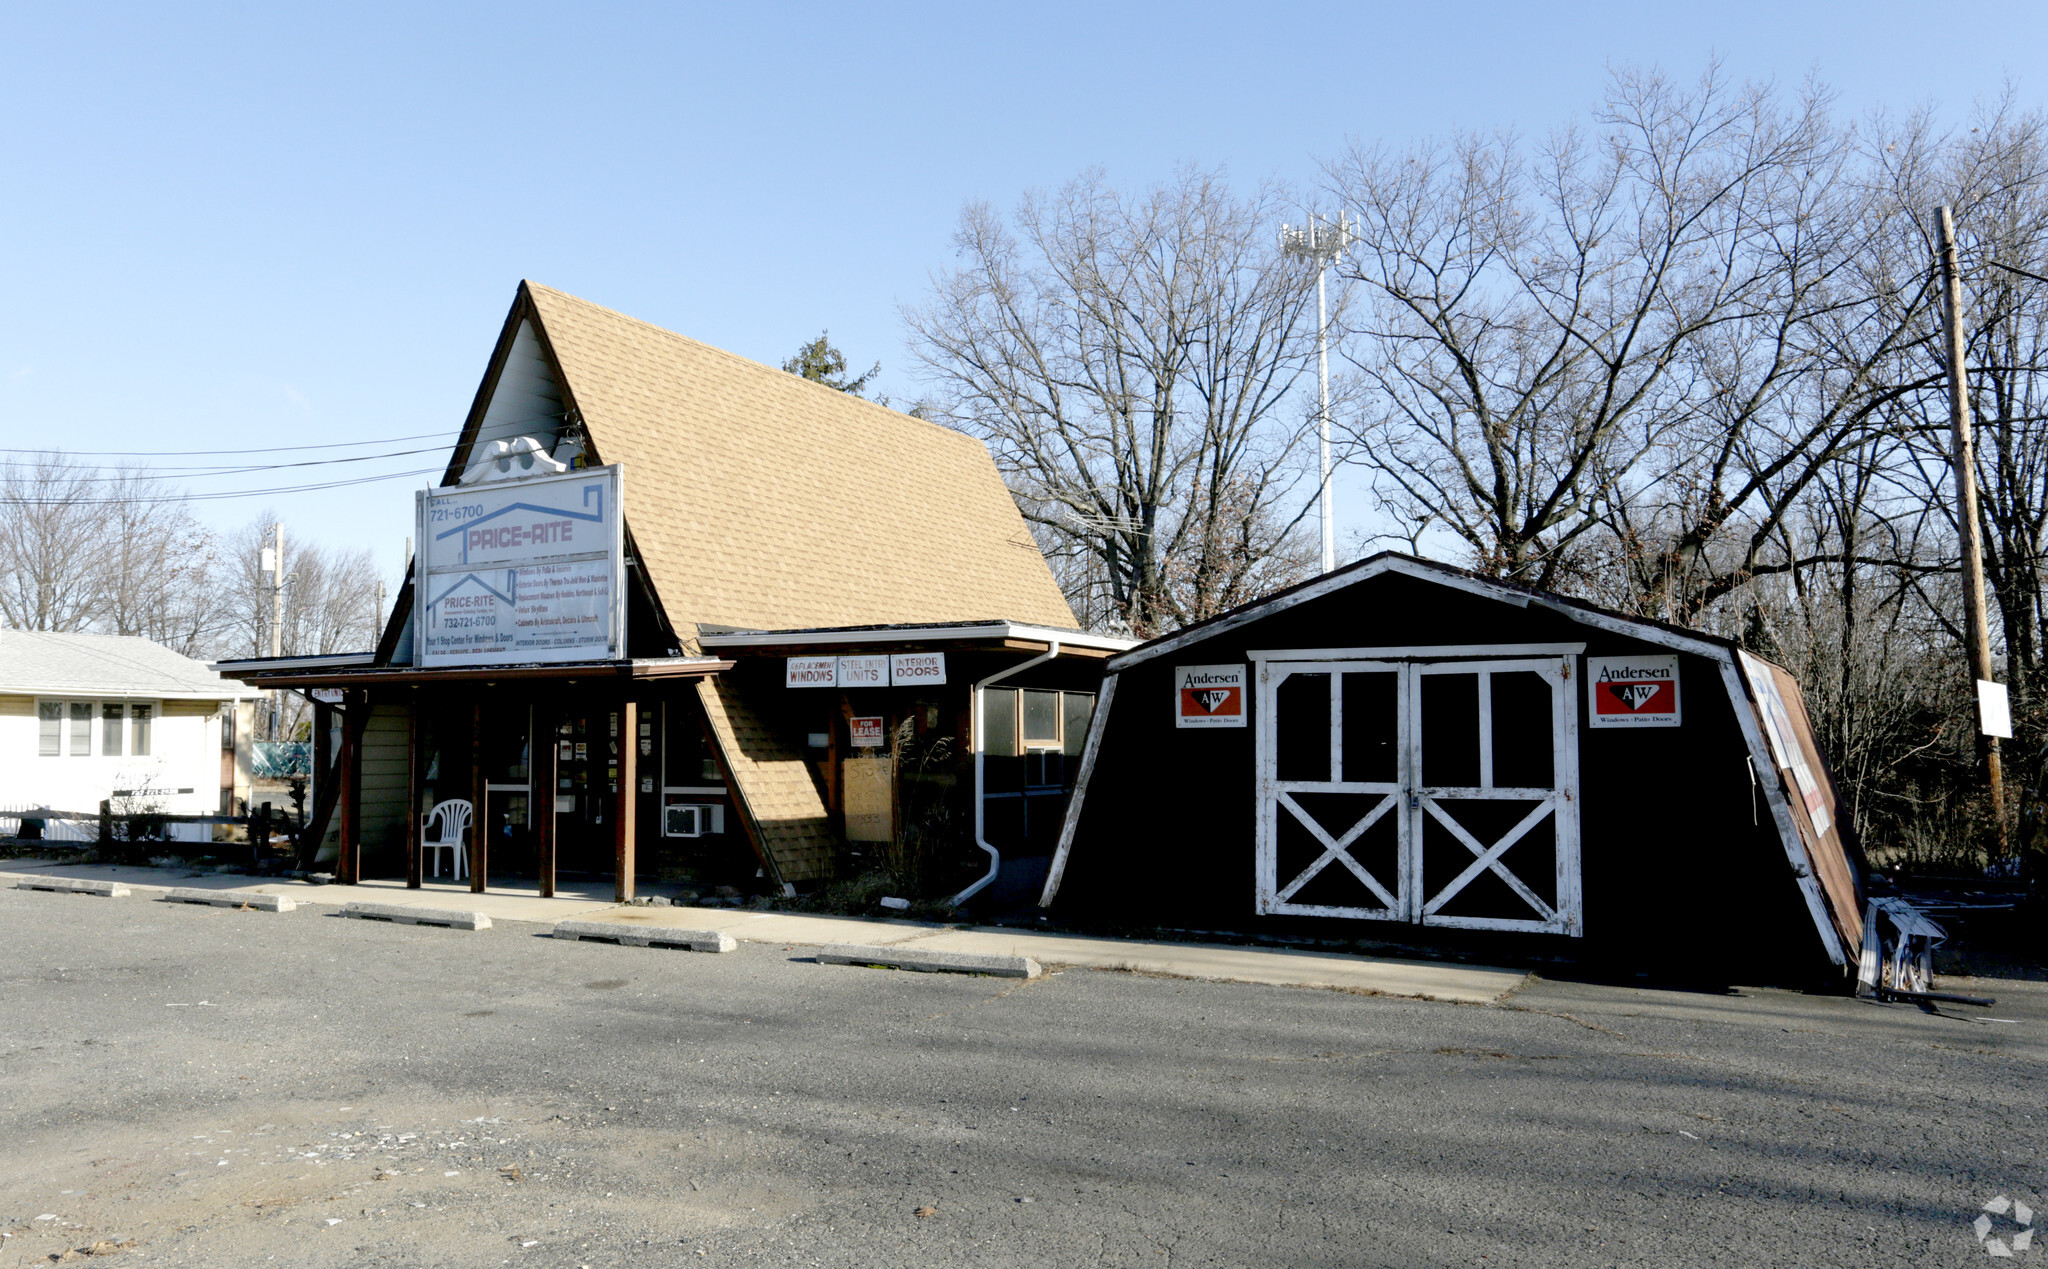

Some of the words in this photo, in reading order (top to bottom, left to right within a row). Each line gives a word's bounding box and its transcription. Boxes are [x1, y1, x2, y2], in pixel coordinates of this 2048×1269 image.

[430, 504, 483, 522] 721-6700
[469, 520, 573, 550] PRICE-RITE
[444, 595, 494, 608] PRICE-RITE
[444, 616, 496, 628] 732-721-6700
[441, 637, 450, 646] Stop
[451, 636, 464, 645] Center
[474, 634, 494, 643] Windows
[495, 633, 498, 642] &
[500, 633, 513, 642] Doors
[790, 662, 834, 670] REPLACEMENT
[841, 660, 863, 669] STEEL
[864, 659, 886, 669] ENTRY
[895, 657, 938, 667] INTERIOR
[790, 670, 833, 682] WINDOWS
[846, 669, 878, 681] UNITS
[896, 667, 939, 677] DOORS
[1598, 664, 1670, 682] Andersen
[1183, 673, 1239, 688] Andersen
[1201, 692, 1224, 704] AW
[1622, 687, 1652, 700] AW
[853, 727, 880, 736] LEASE
